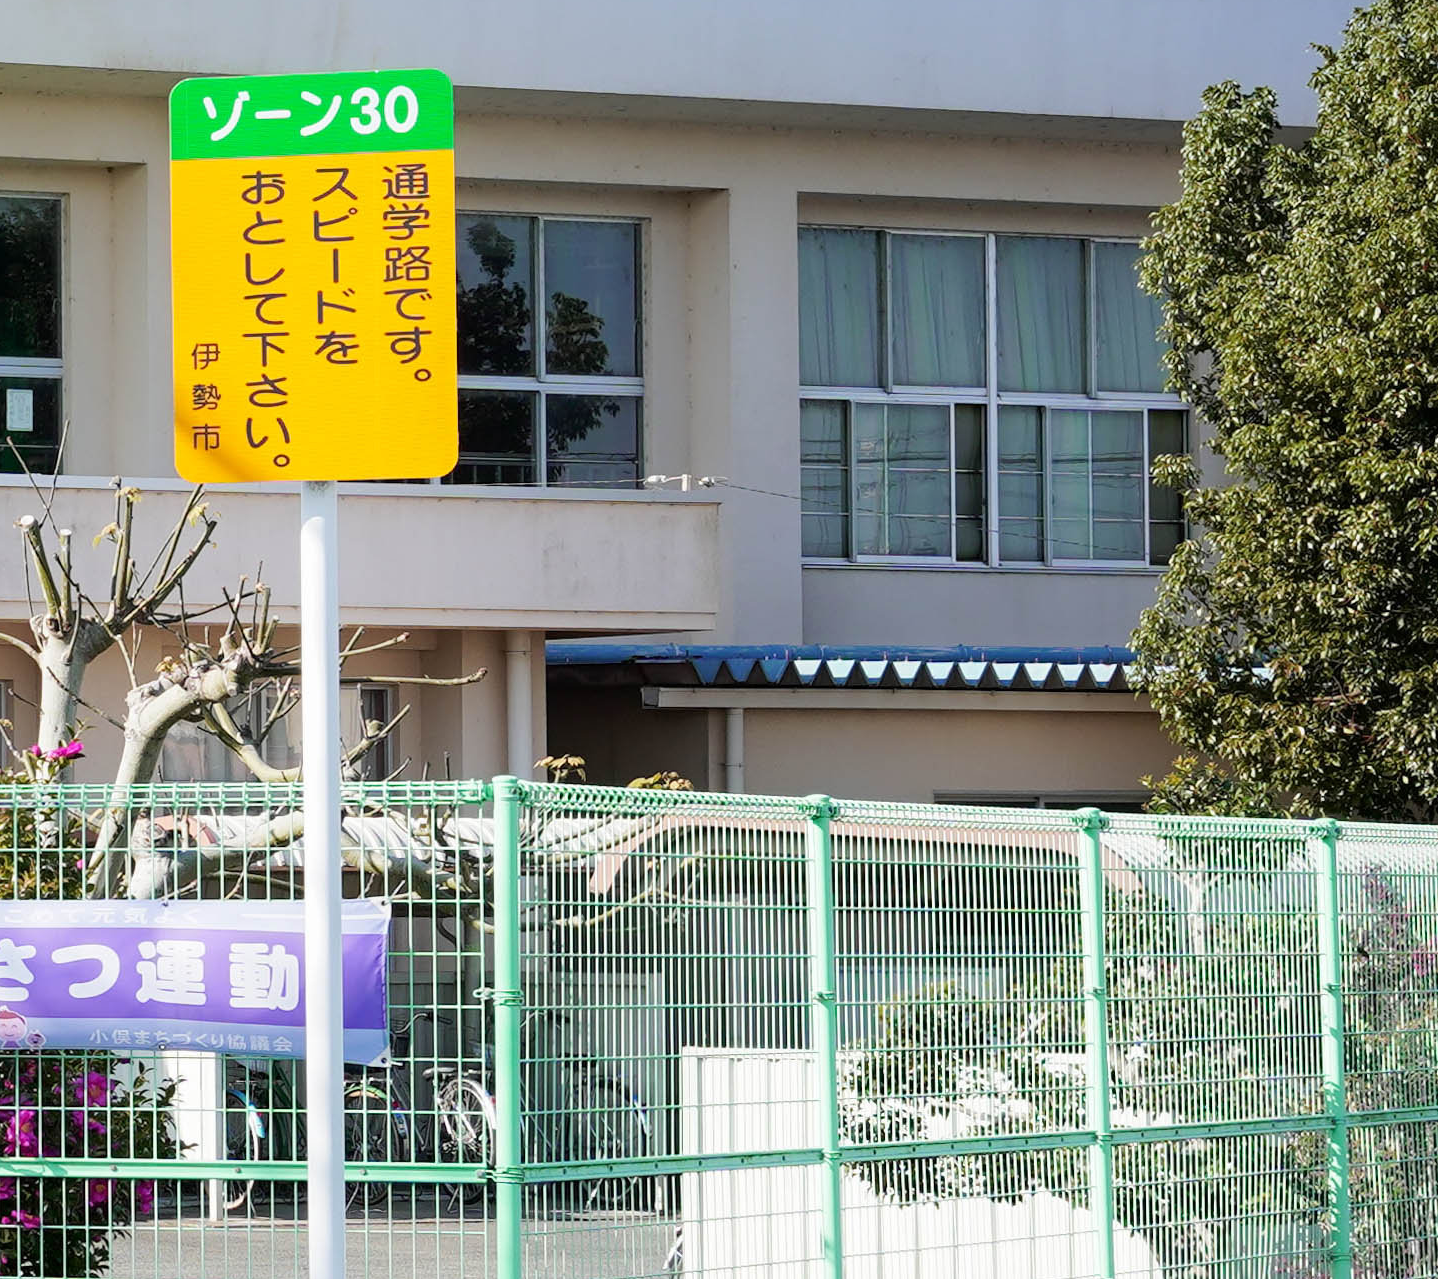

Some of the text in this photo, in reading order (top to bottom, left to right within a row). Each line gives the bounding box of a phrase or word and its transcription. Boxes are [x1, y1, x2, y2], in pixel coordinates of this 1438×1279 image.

[202, 85, 419, 142] ゾーン30
[241, 170, 291, 468] おとして下さい。
[312, 167, 358, 365] スピードを
[382, 163, 433, 382] 通学路です。
[191, 342, 222, 452] 伊勢市
[88, 1028, 294, 1053] 小俣まちづくり協議会
